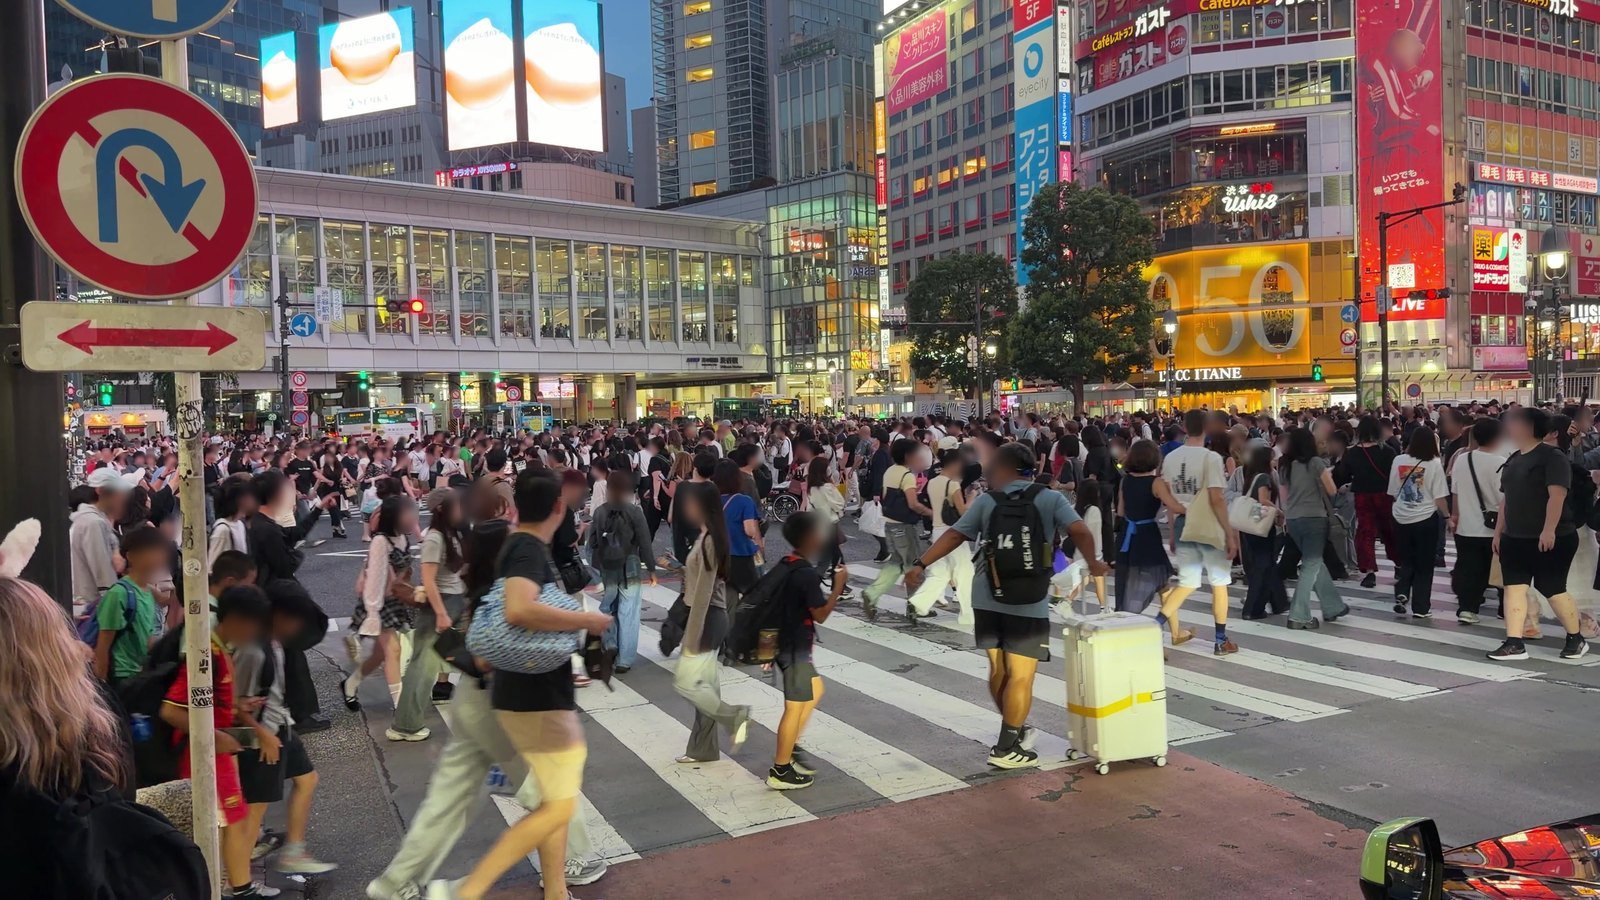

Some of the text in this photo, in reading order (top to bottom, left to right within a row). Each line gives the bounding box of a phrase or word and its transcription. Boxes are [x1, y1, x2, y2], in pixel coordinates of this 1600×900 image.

[1026, 2, 1040, 20] 5F
[1135, 6, 1171, 37] ガスト
[911, 19, 944, 45] 品川スキン
[912, 35, 941, 60] クリニック
[1118, 42, 1162, 79] ガスト
[895, 67, 944, 105] 品川美容外科
[1018, 77, 1049, 98] eyecity
[1080, 68, 1094, 87] 7F
[1382, 169, 1417, 183] いつでも
[1226, 185, 1248, 196] 渋谷
[1373, 178, 1430, 196] 帰ってきてね。
[1221, 193, 1278, 213] Ushi8
[997, 533, 1014, 550] 14
